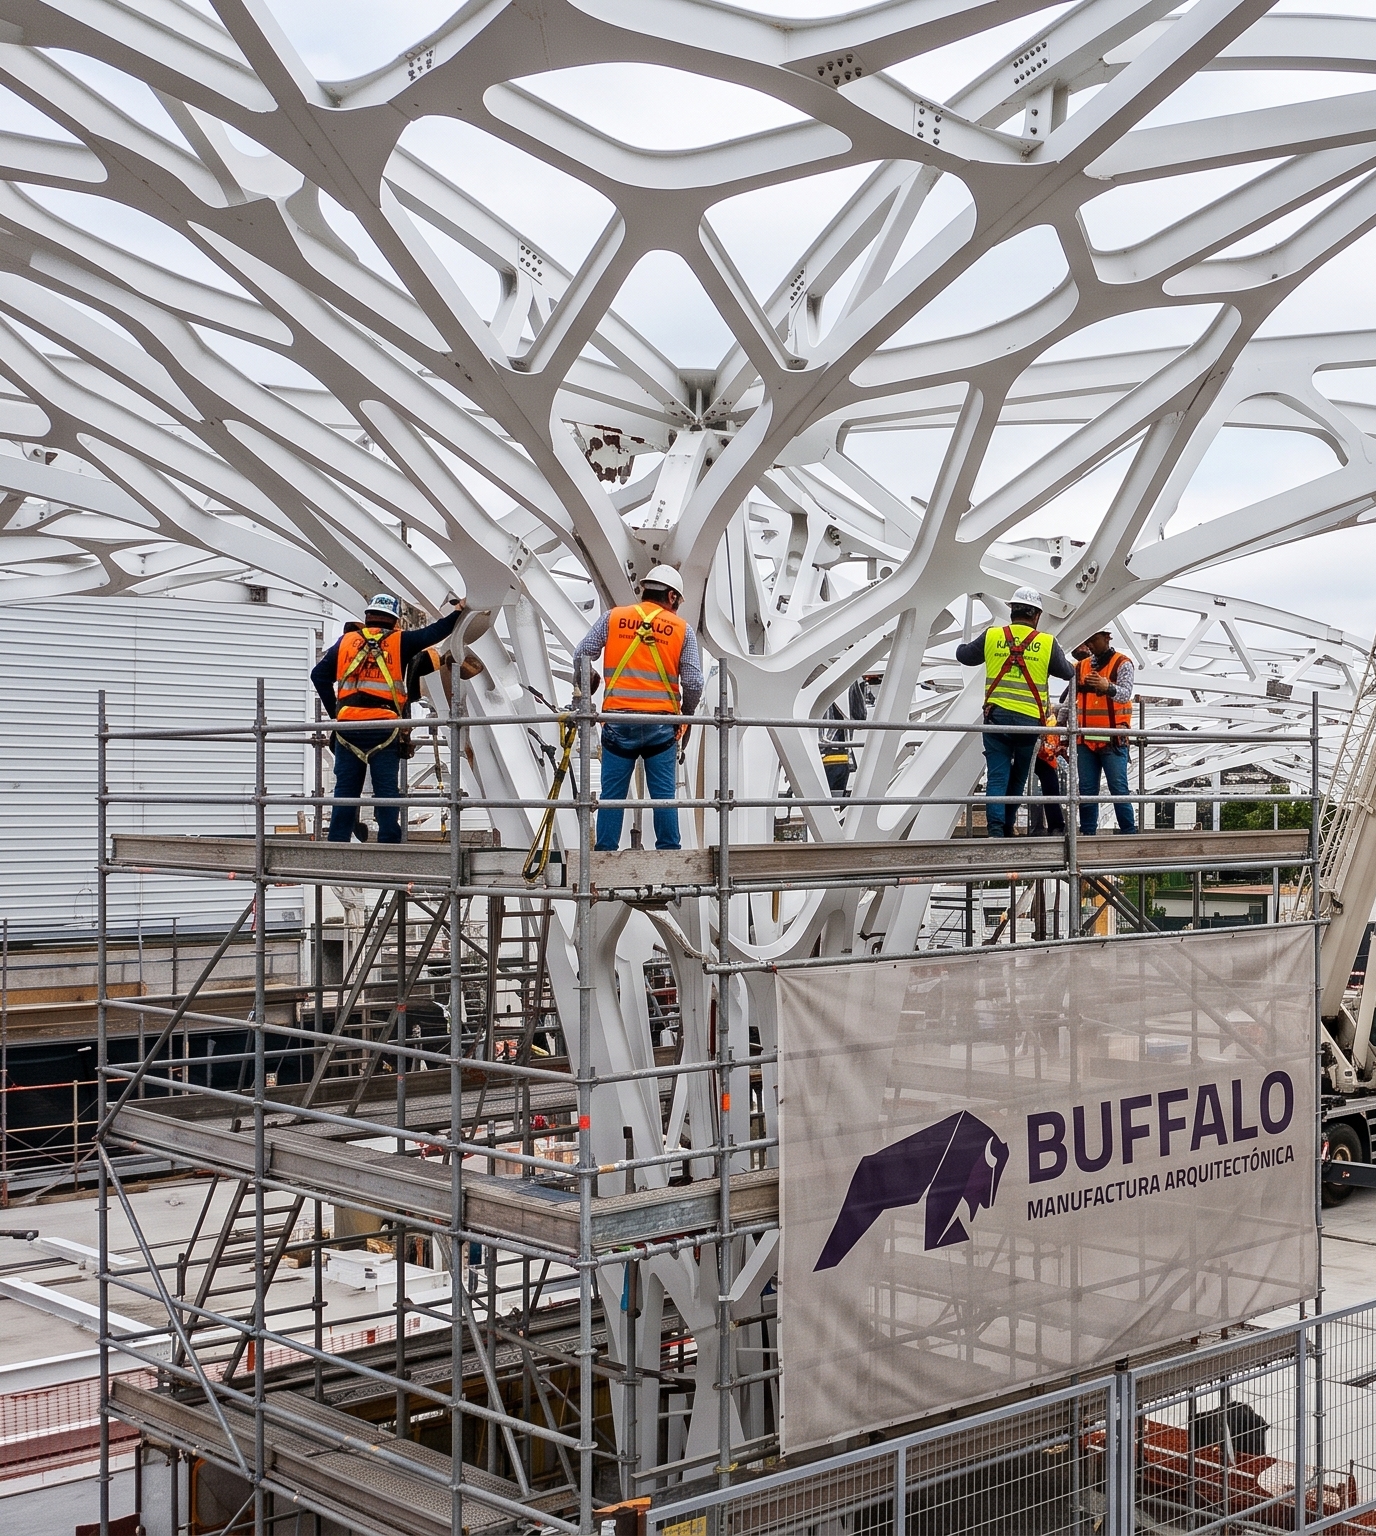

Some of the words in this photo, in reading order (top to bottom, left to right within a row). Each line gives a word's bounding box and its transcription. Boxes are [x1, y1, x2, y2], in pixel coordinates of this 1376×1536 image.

[1027, 1070, 1294, 1184] BUFFALO
[1027, 1174, 1160, 1221] MANUFACTURA
[1164, 1145, 1295, 1191] ARQUITECTÓNICA
